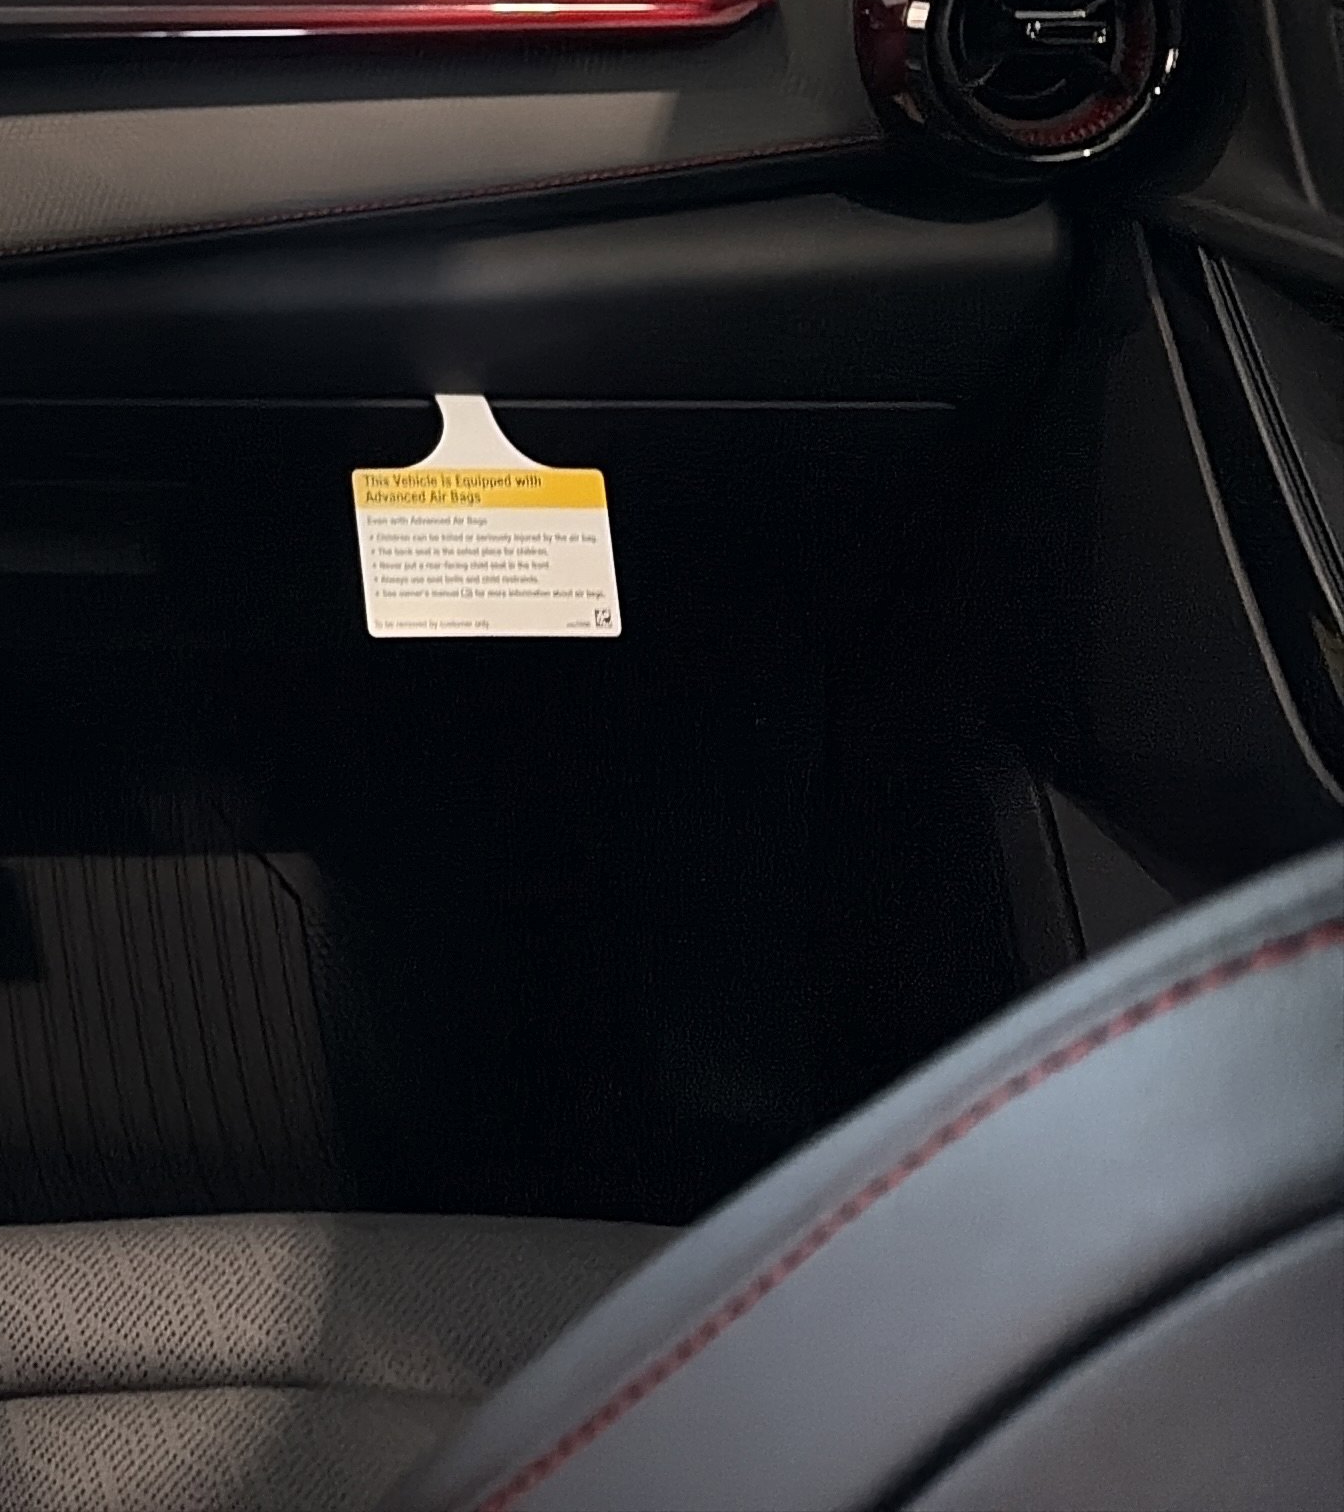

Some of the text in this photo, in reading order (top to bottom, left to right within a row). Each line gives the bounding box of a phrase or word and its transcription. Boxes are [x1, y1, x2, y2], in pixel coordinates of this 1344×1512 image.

[365, 473, 542, 490] This Vehicle is Equipped with
[365, 490, 481, 507] Advanced Air Bags
[411, 516, 451, 525] Advanced
[453, 516, 465, 525] Air
